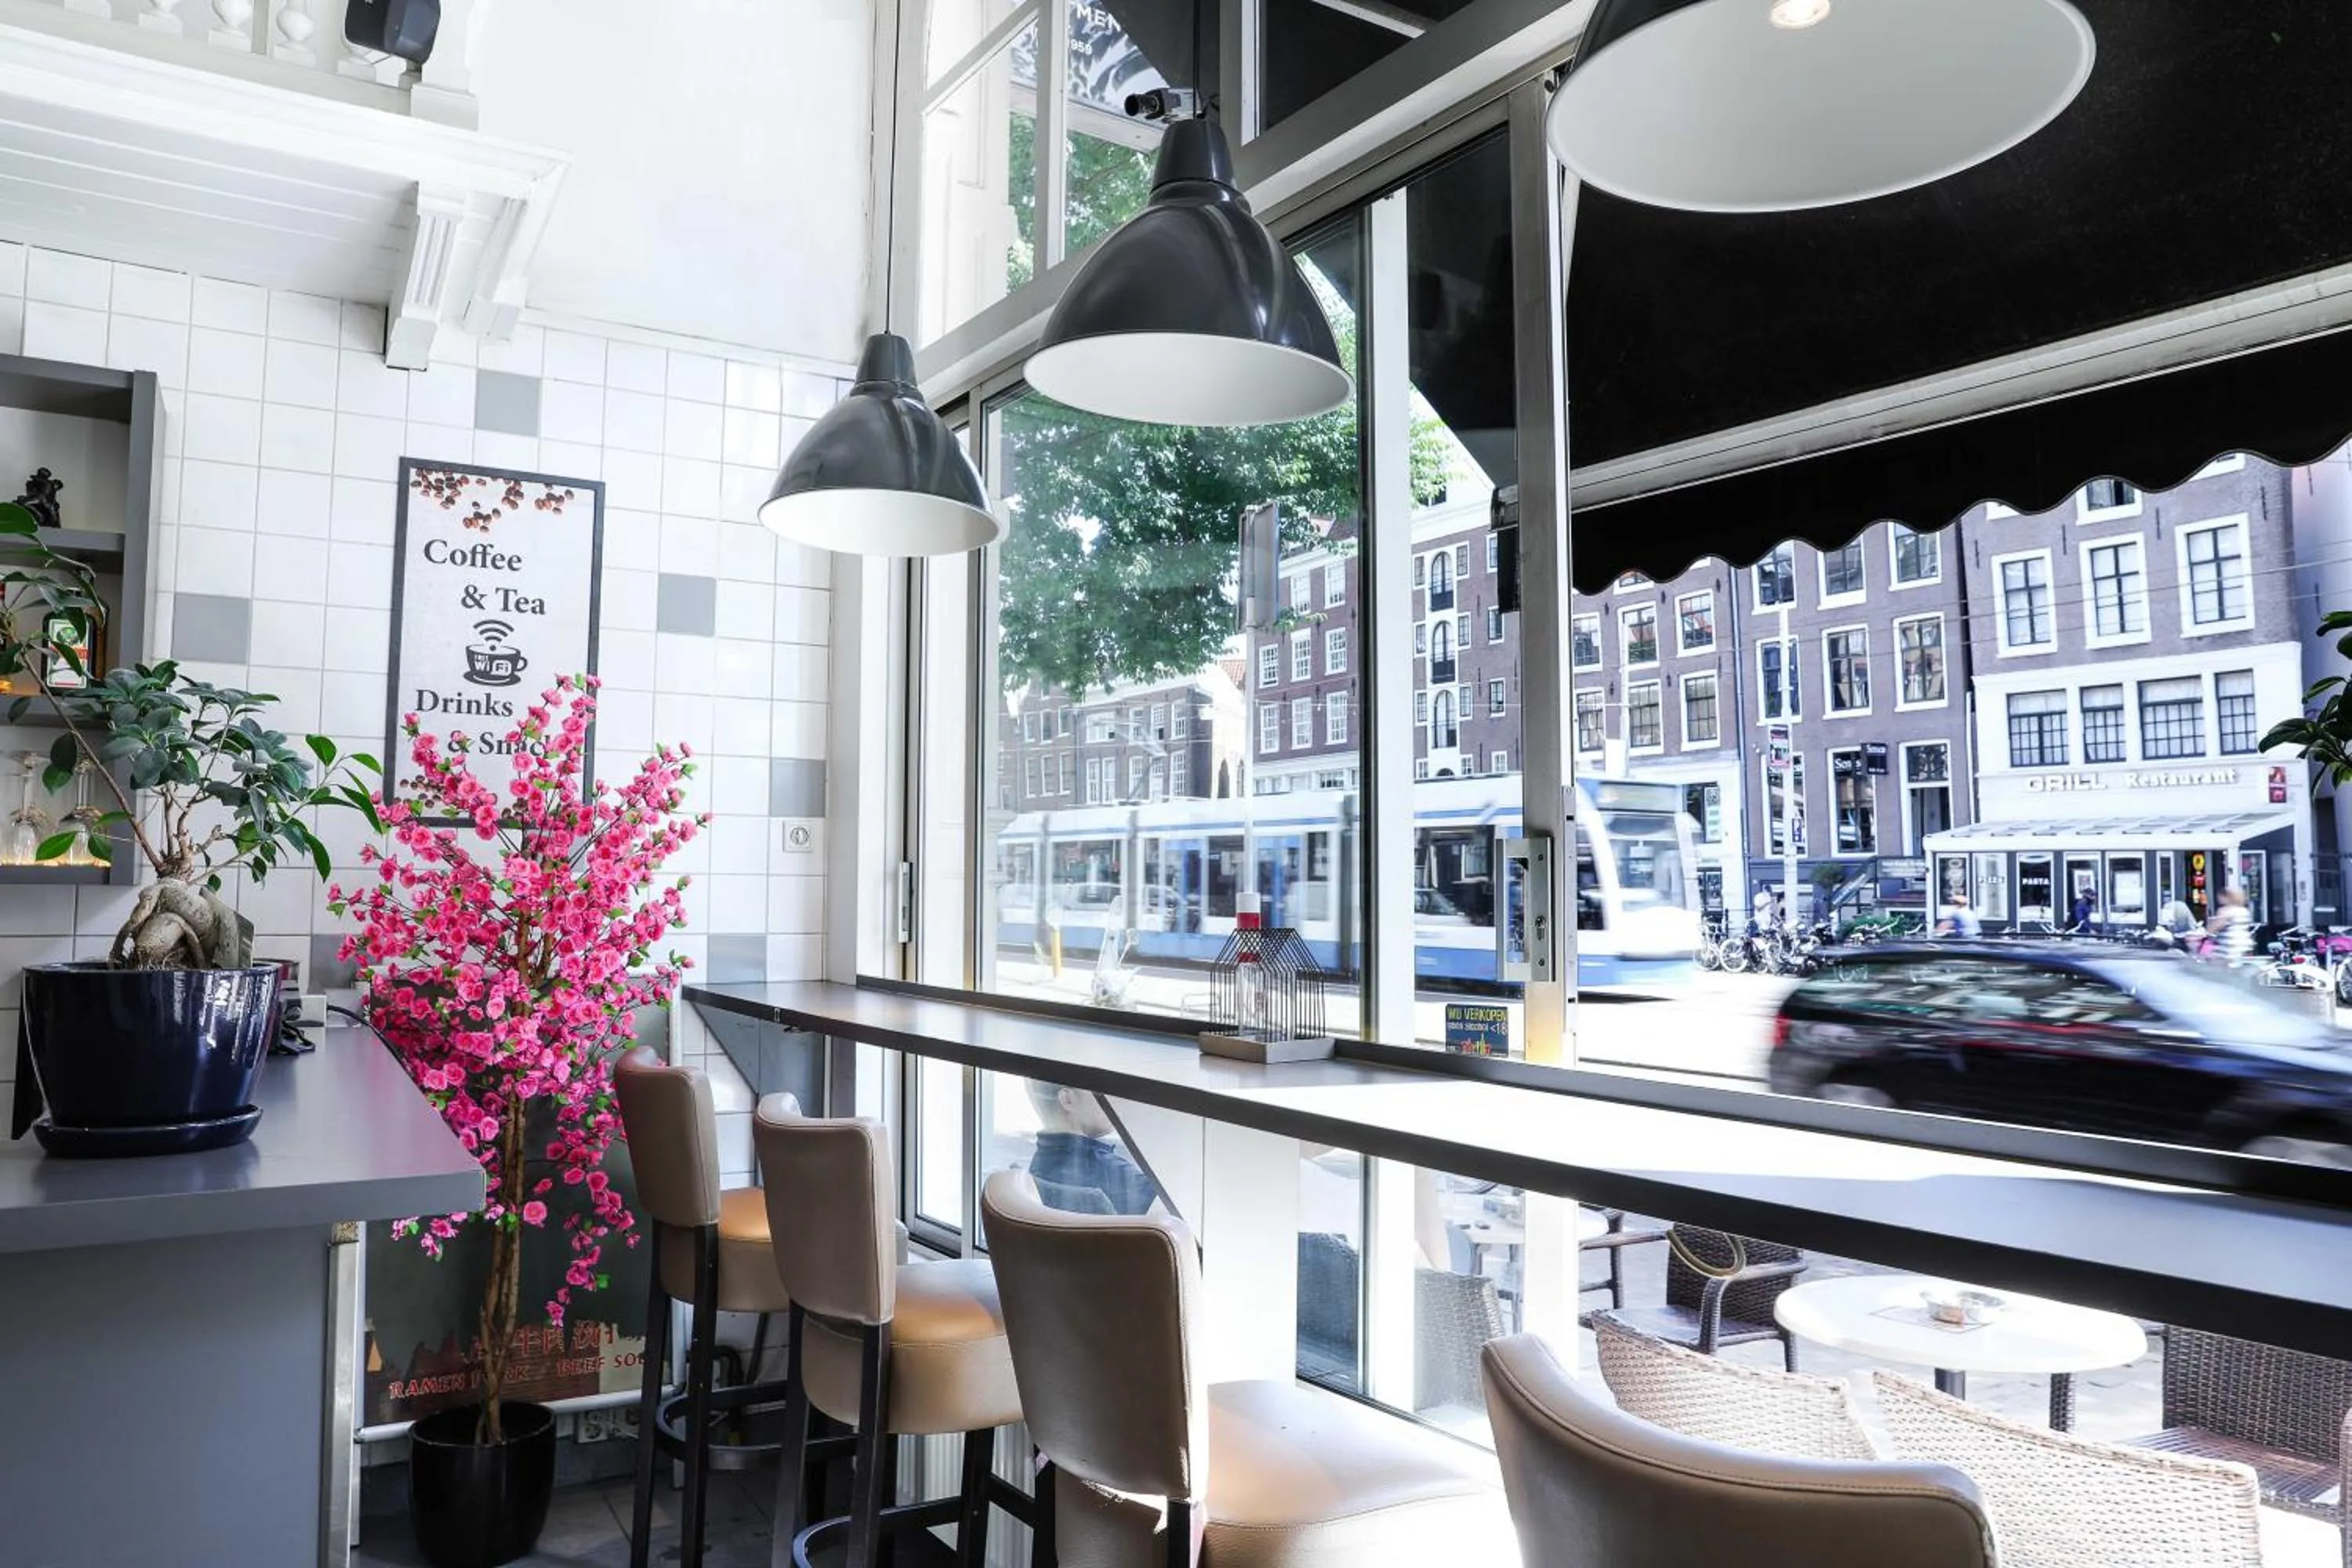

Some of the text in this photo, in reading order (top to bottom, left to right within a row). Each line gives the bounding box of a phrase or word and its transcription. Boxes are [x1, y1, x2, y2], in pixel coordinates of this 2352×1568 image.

[1070, 1, 1121, 32] MEN
[423, 539, 522, 572] Coffee
[461, 584, 546, 615] & Tea
[416, 689, 514, 717] Drinks
[2026, 768, 2238, 792] GRILL Restaurant
[2022, 877, 2050, 886] PASTA
[390, 1374, 465, 1399] RAMEN
